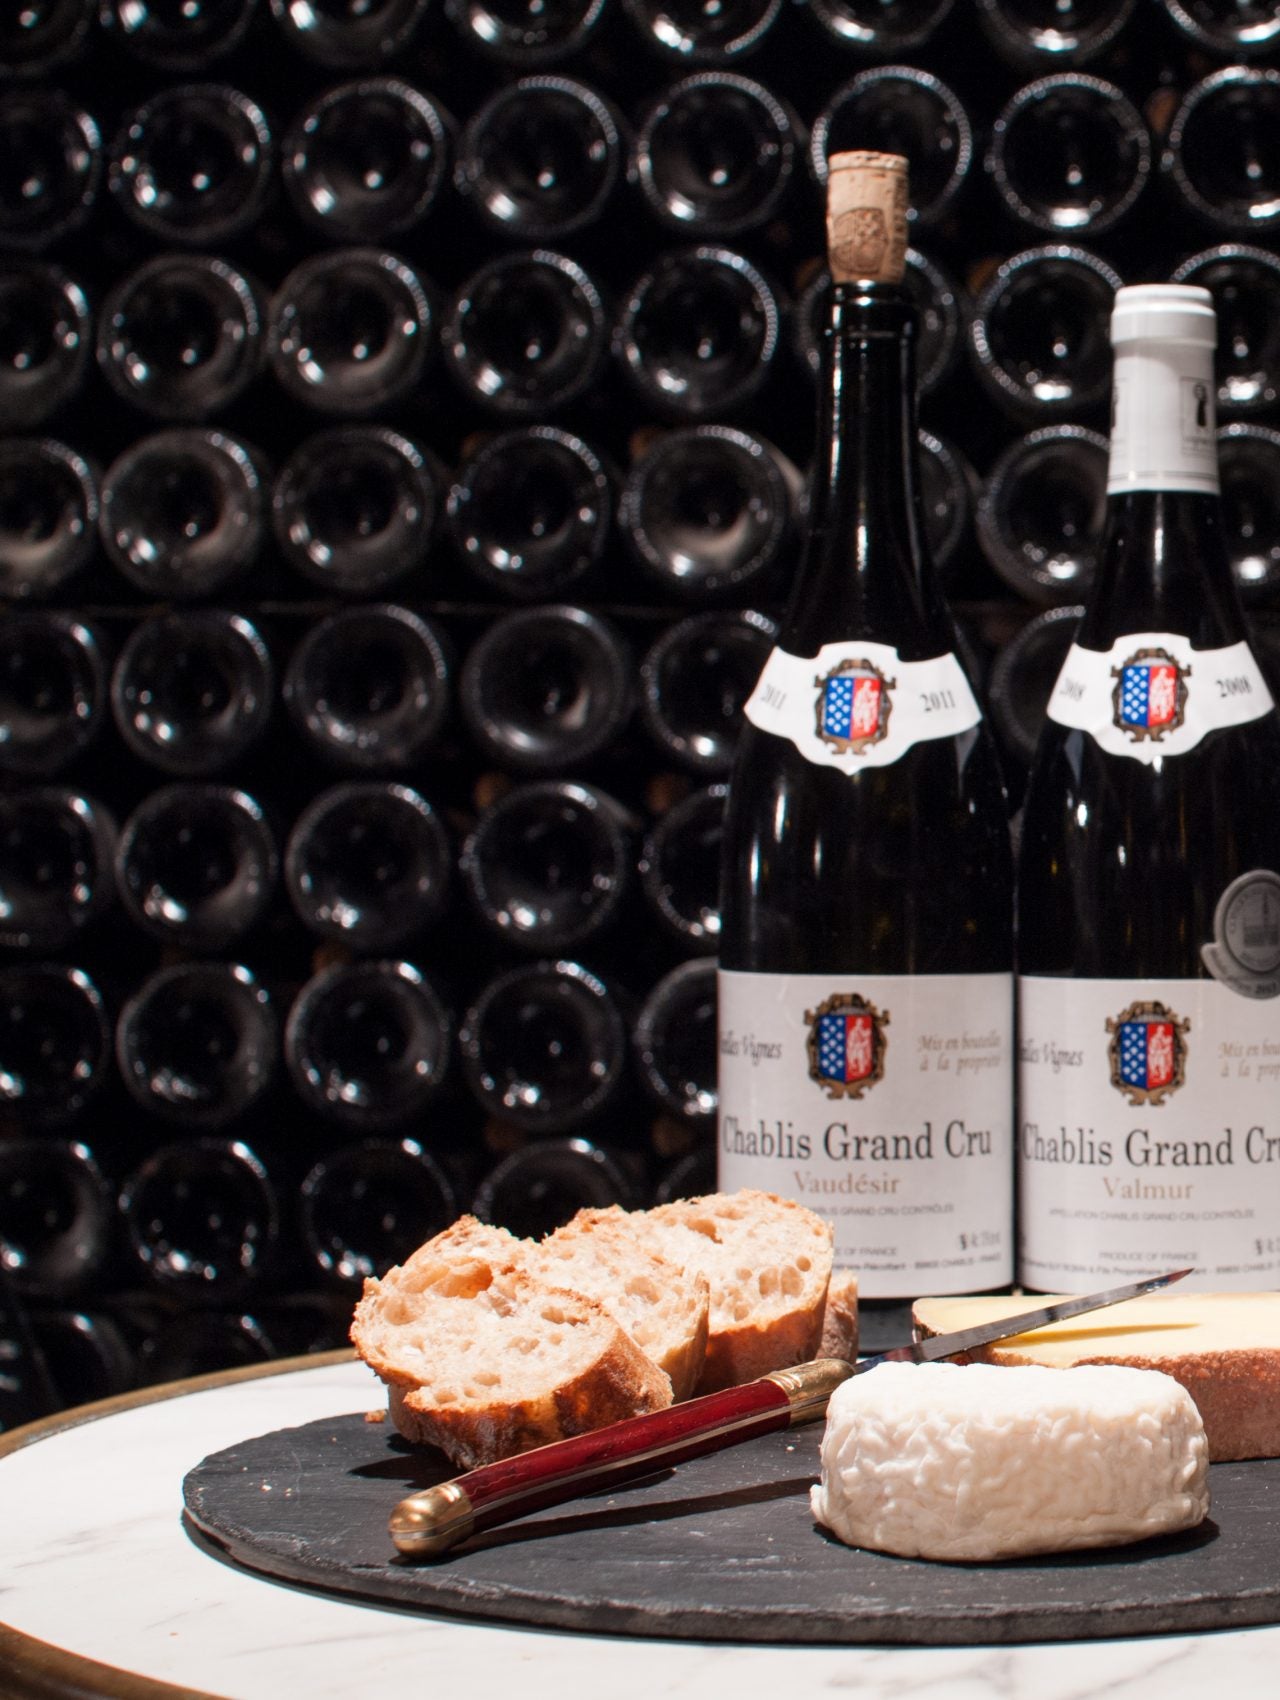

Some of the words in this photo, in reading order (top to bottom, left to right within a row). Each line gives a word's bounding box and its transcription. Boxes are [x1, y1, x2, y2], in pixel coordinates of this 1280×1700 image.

[920, 690, 956, 712] 2011
[917, 1033, 943, 1052] Mis
[1217, 1040, 1243, 1059] Mis
[722, 1114, 812, 1160] Chablis
[823, 1121, 934, 1161] Grand
[944, 1119, 992, 1159] Cru
[1022, 1121, 1113, 1167] Chablis
[1125, 1127, 1234, 1167] Grand
[792, 1170, 902, 1195] Vaudésir
[1102, 1175, 1195, 1200] Valmur
